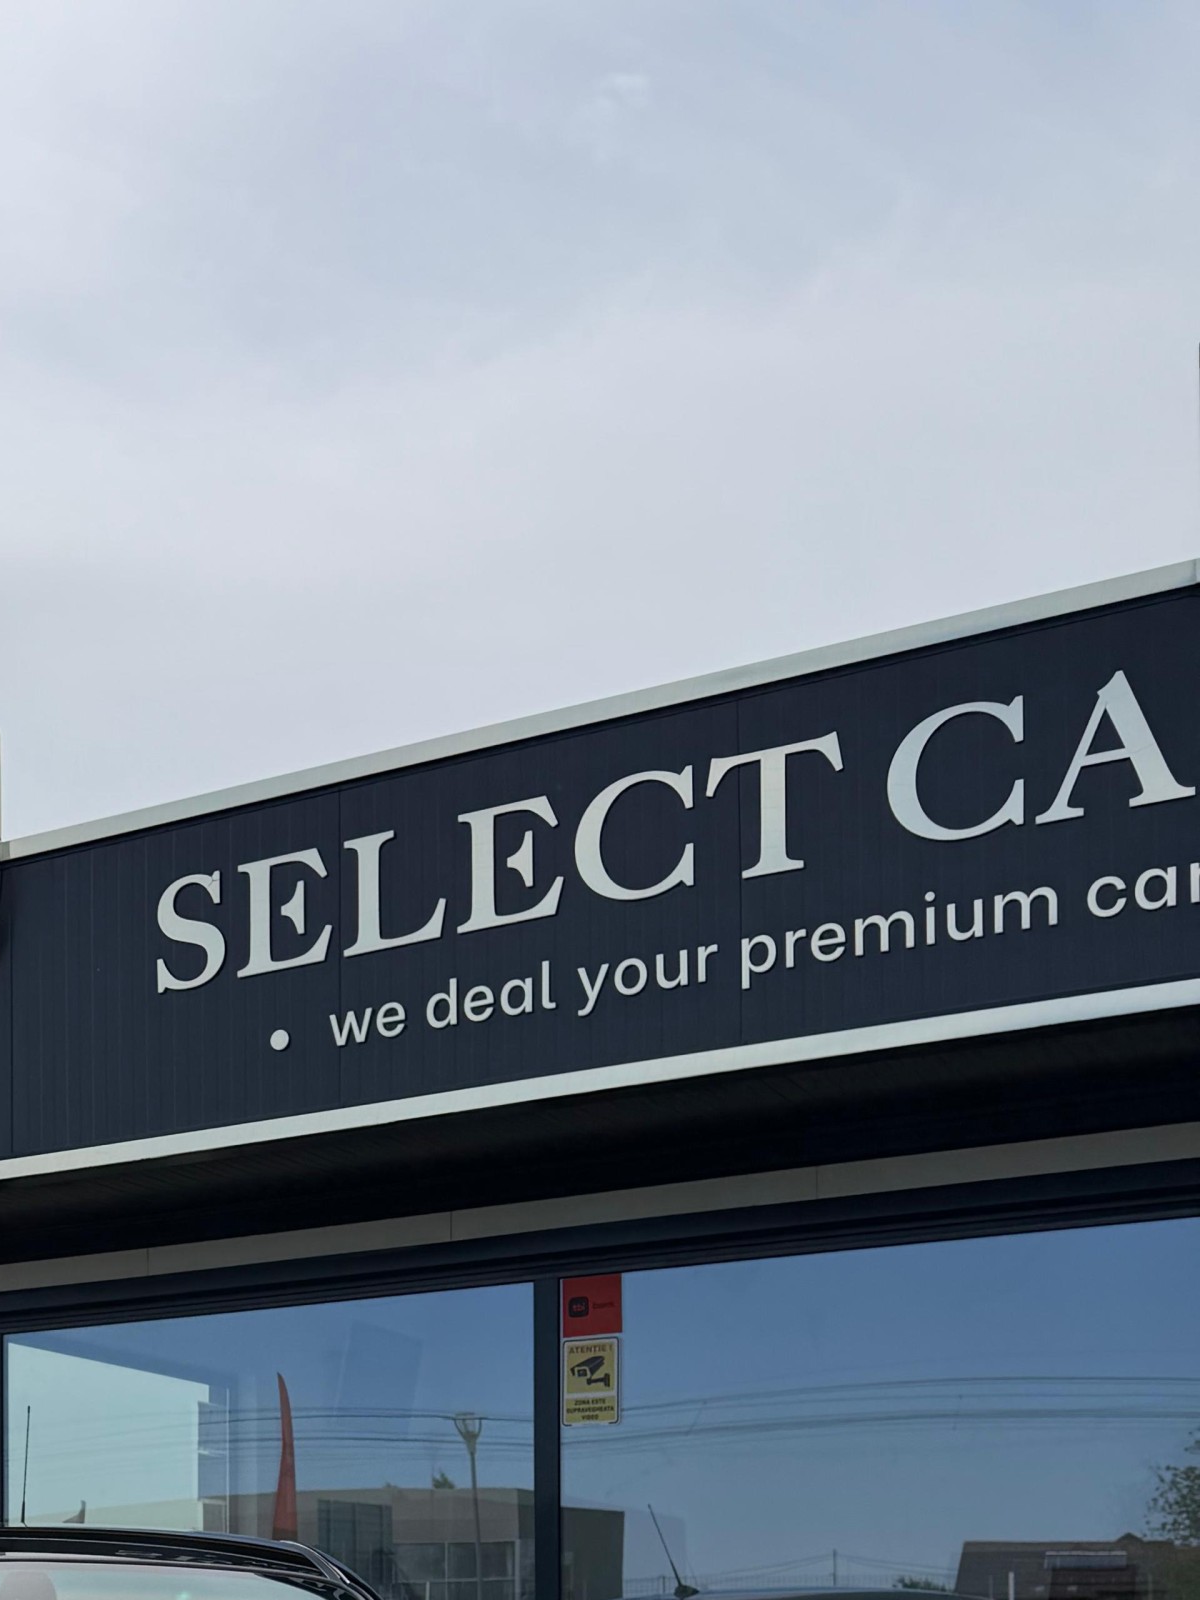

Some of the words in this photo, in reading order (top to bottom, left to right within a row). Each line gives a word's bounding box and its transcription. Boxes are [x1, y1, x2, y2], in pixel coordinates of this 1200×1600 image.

[157, 731, 844, 994] SELECT
[887, 670, 1196, 841] CA
[329, 1001, 406, 1047] we
[426, 960, 557, 1029] deal
[577, 943, 718, 1017] your
[741, 886, 1058, 990] premium
